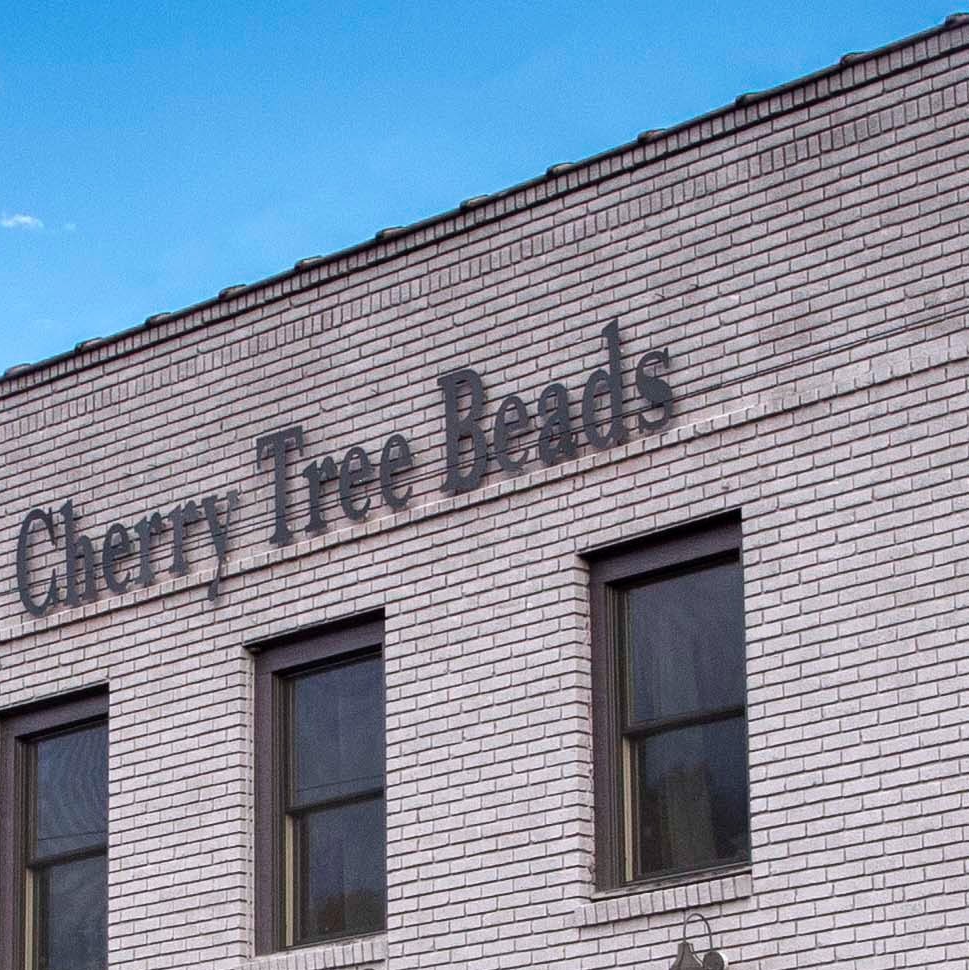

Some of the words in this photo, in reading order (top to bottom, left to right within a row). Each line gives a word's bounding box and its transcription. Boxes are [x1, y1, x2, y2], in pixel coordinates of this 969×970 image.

[16, 488, 237, 616] Cherry
[257, 425, 414, 546] Tree
[437, 318, 675, 494] Beads
